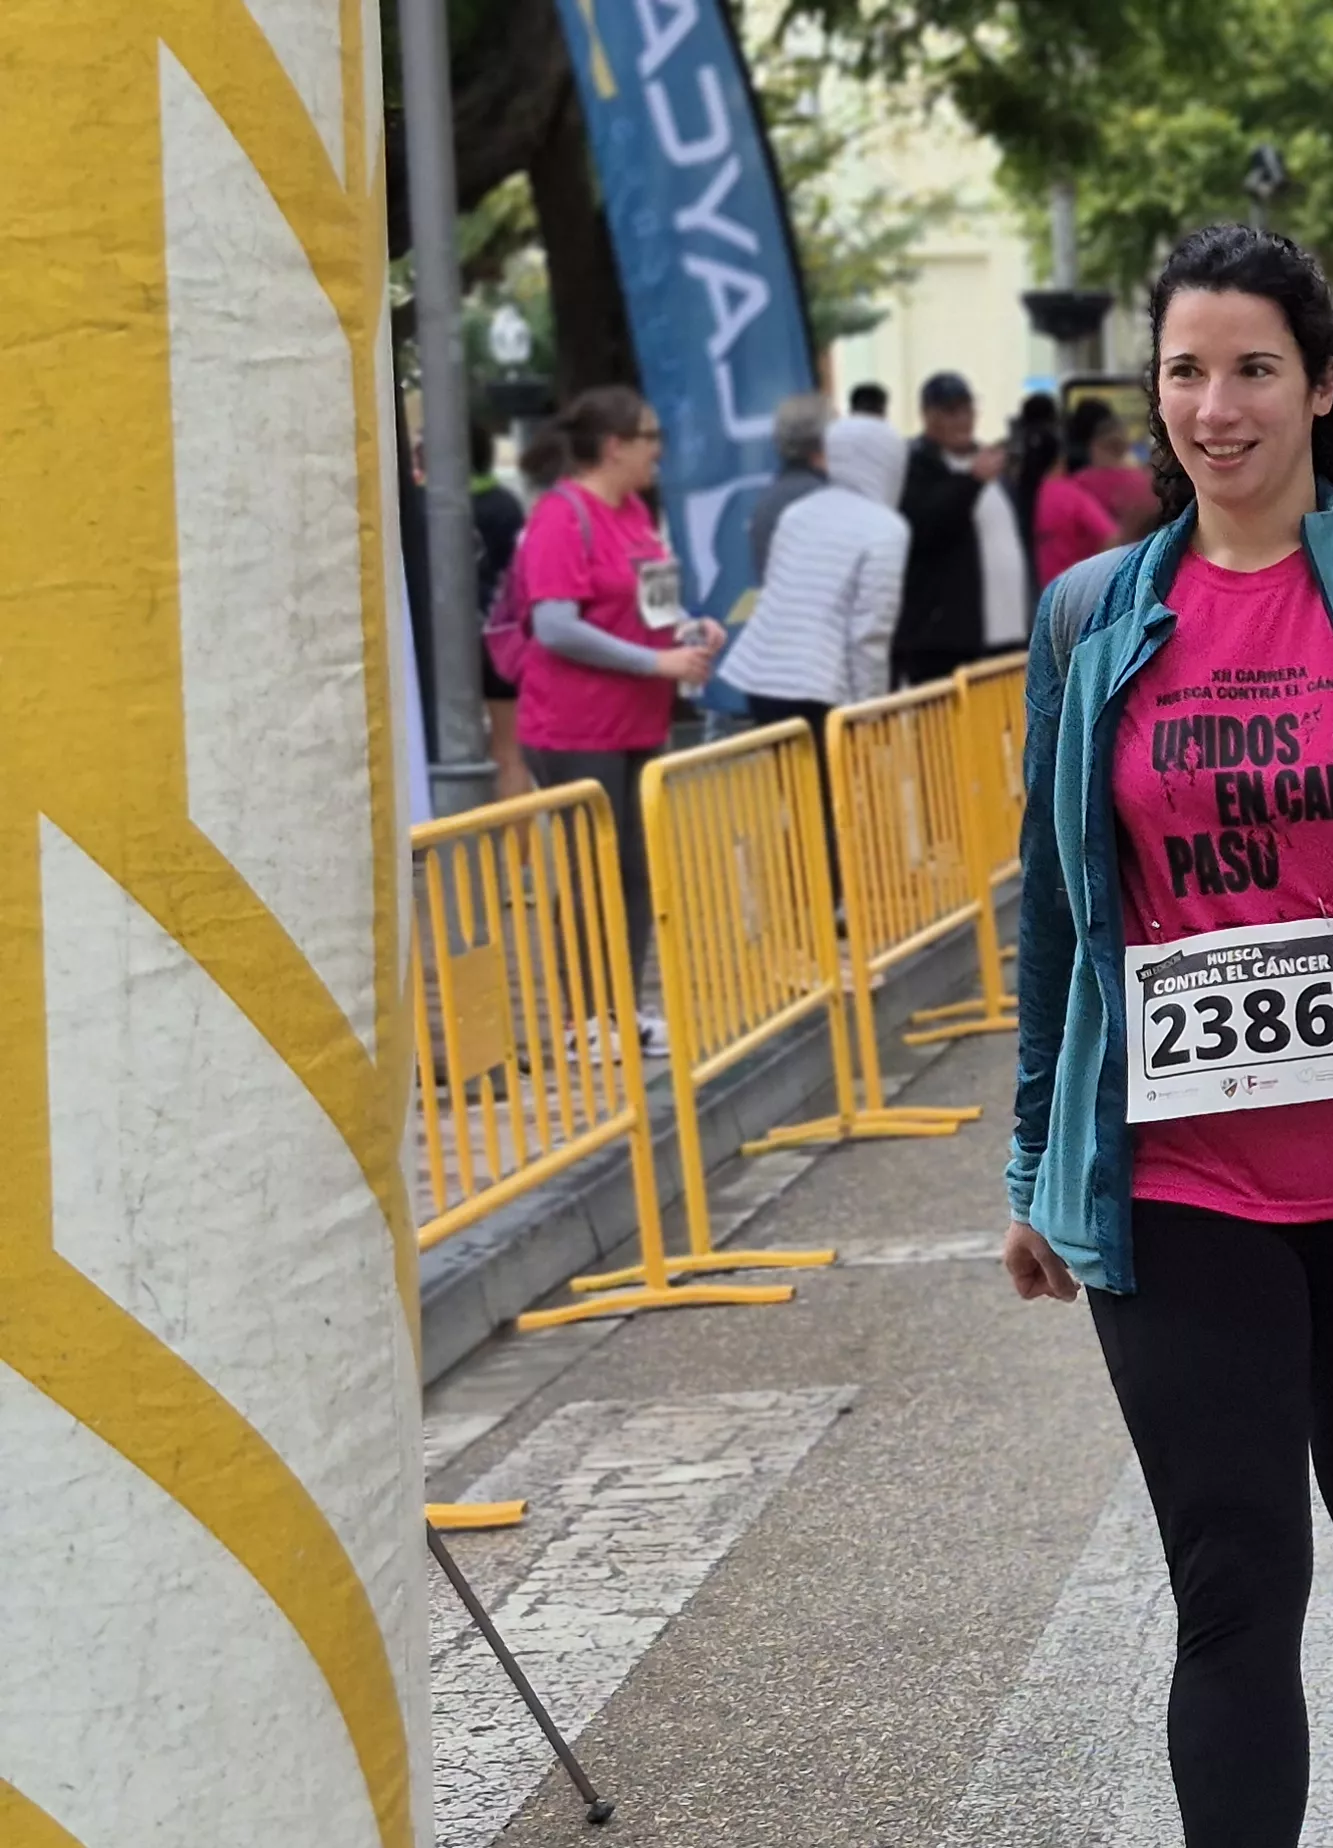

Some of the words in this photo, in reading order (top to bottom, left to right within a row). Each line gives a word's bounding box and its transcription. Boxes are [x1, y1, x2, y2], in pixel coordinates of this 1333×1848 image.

[1217, 686, 1280, 700] CONTRA
[1235, 666, 1308, 683] CARRERA
[1152, 712, 1300, 771] UNIDOS
[1214, 770, 1270, 827] EN
[1164, 830, 1280, 898] PASO
[1153, 969, 1222, 995] CONTRA
[1226, 964, 1250, 982] EL
[1252, 954, 1331, 978] CÁNCER
[1207, 947, 1263, 966] HUESCA
